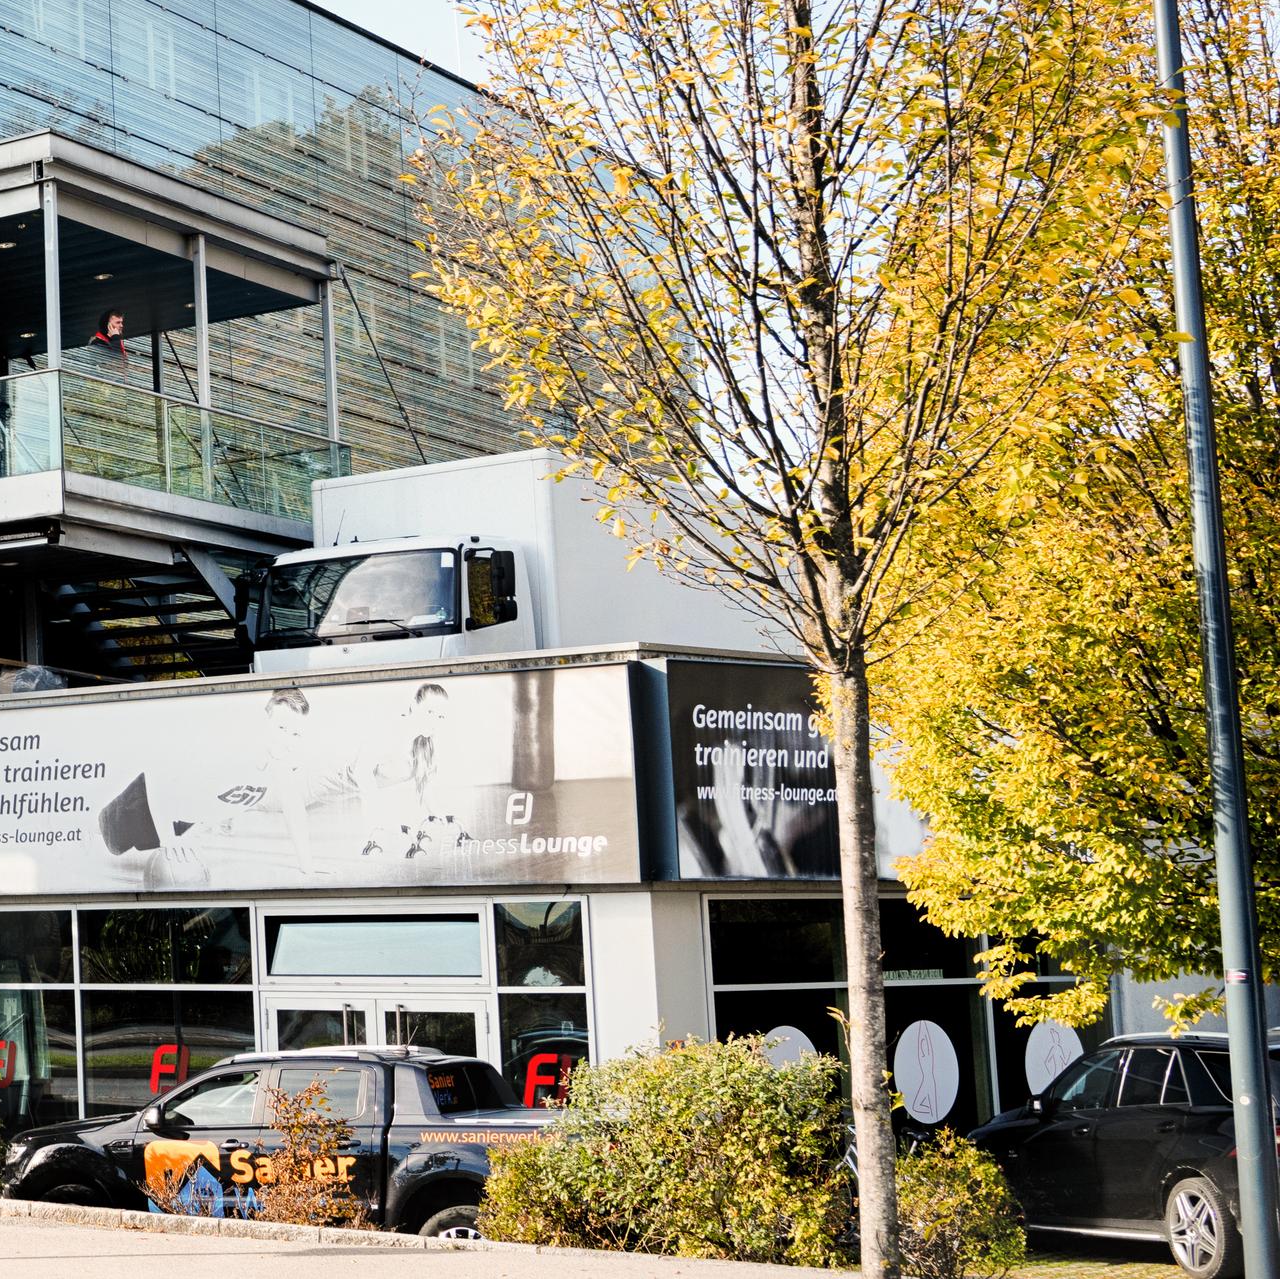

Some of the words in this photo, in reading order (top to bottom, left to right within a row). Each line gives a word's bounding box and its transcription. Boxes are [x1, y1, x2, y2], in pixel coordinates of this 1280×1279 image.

[692, 703, 802, 732] Gemeinsam
[694, 739, 789, 768] trainieren
[794, 743, 829, 769] und
[3, 758, 106, 783] trainieren
[428, 1072, 455, 1089] Sanier
